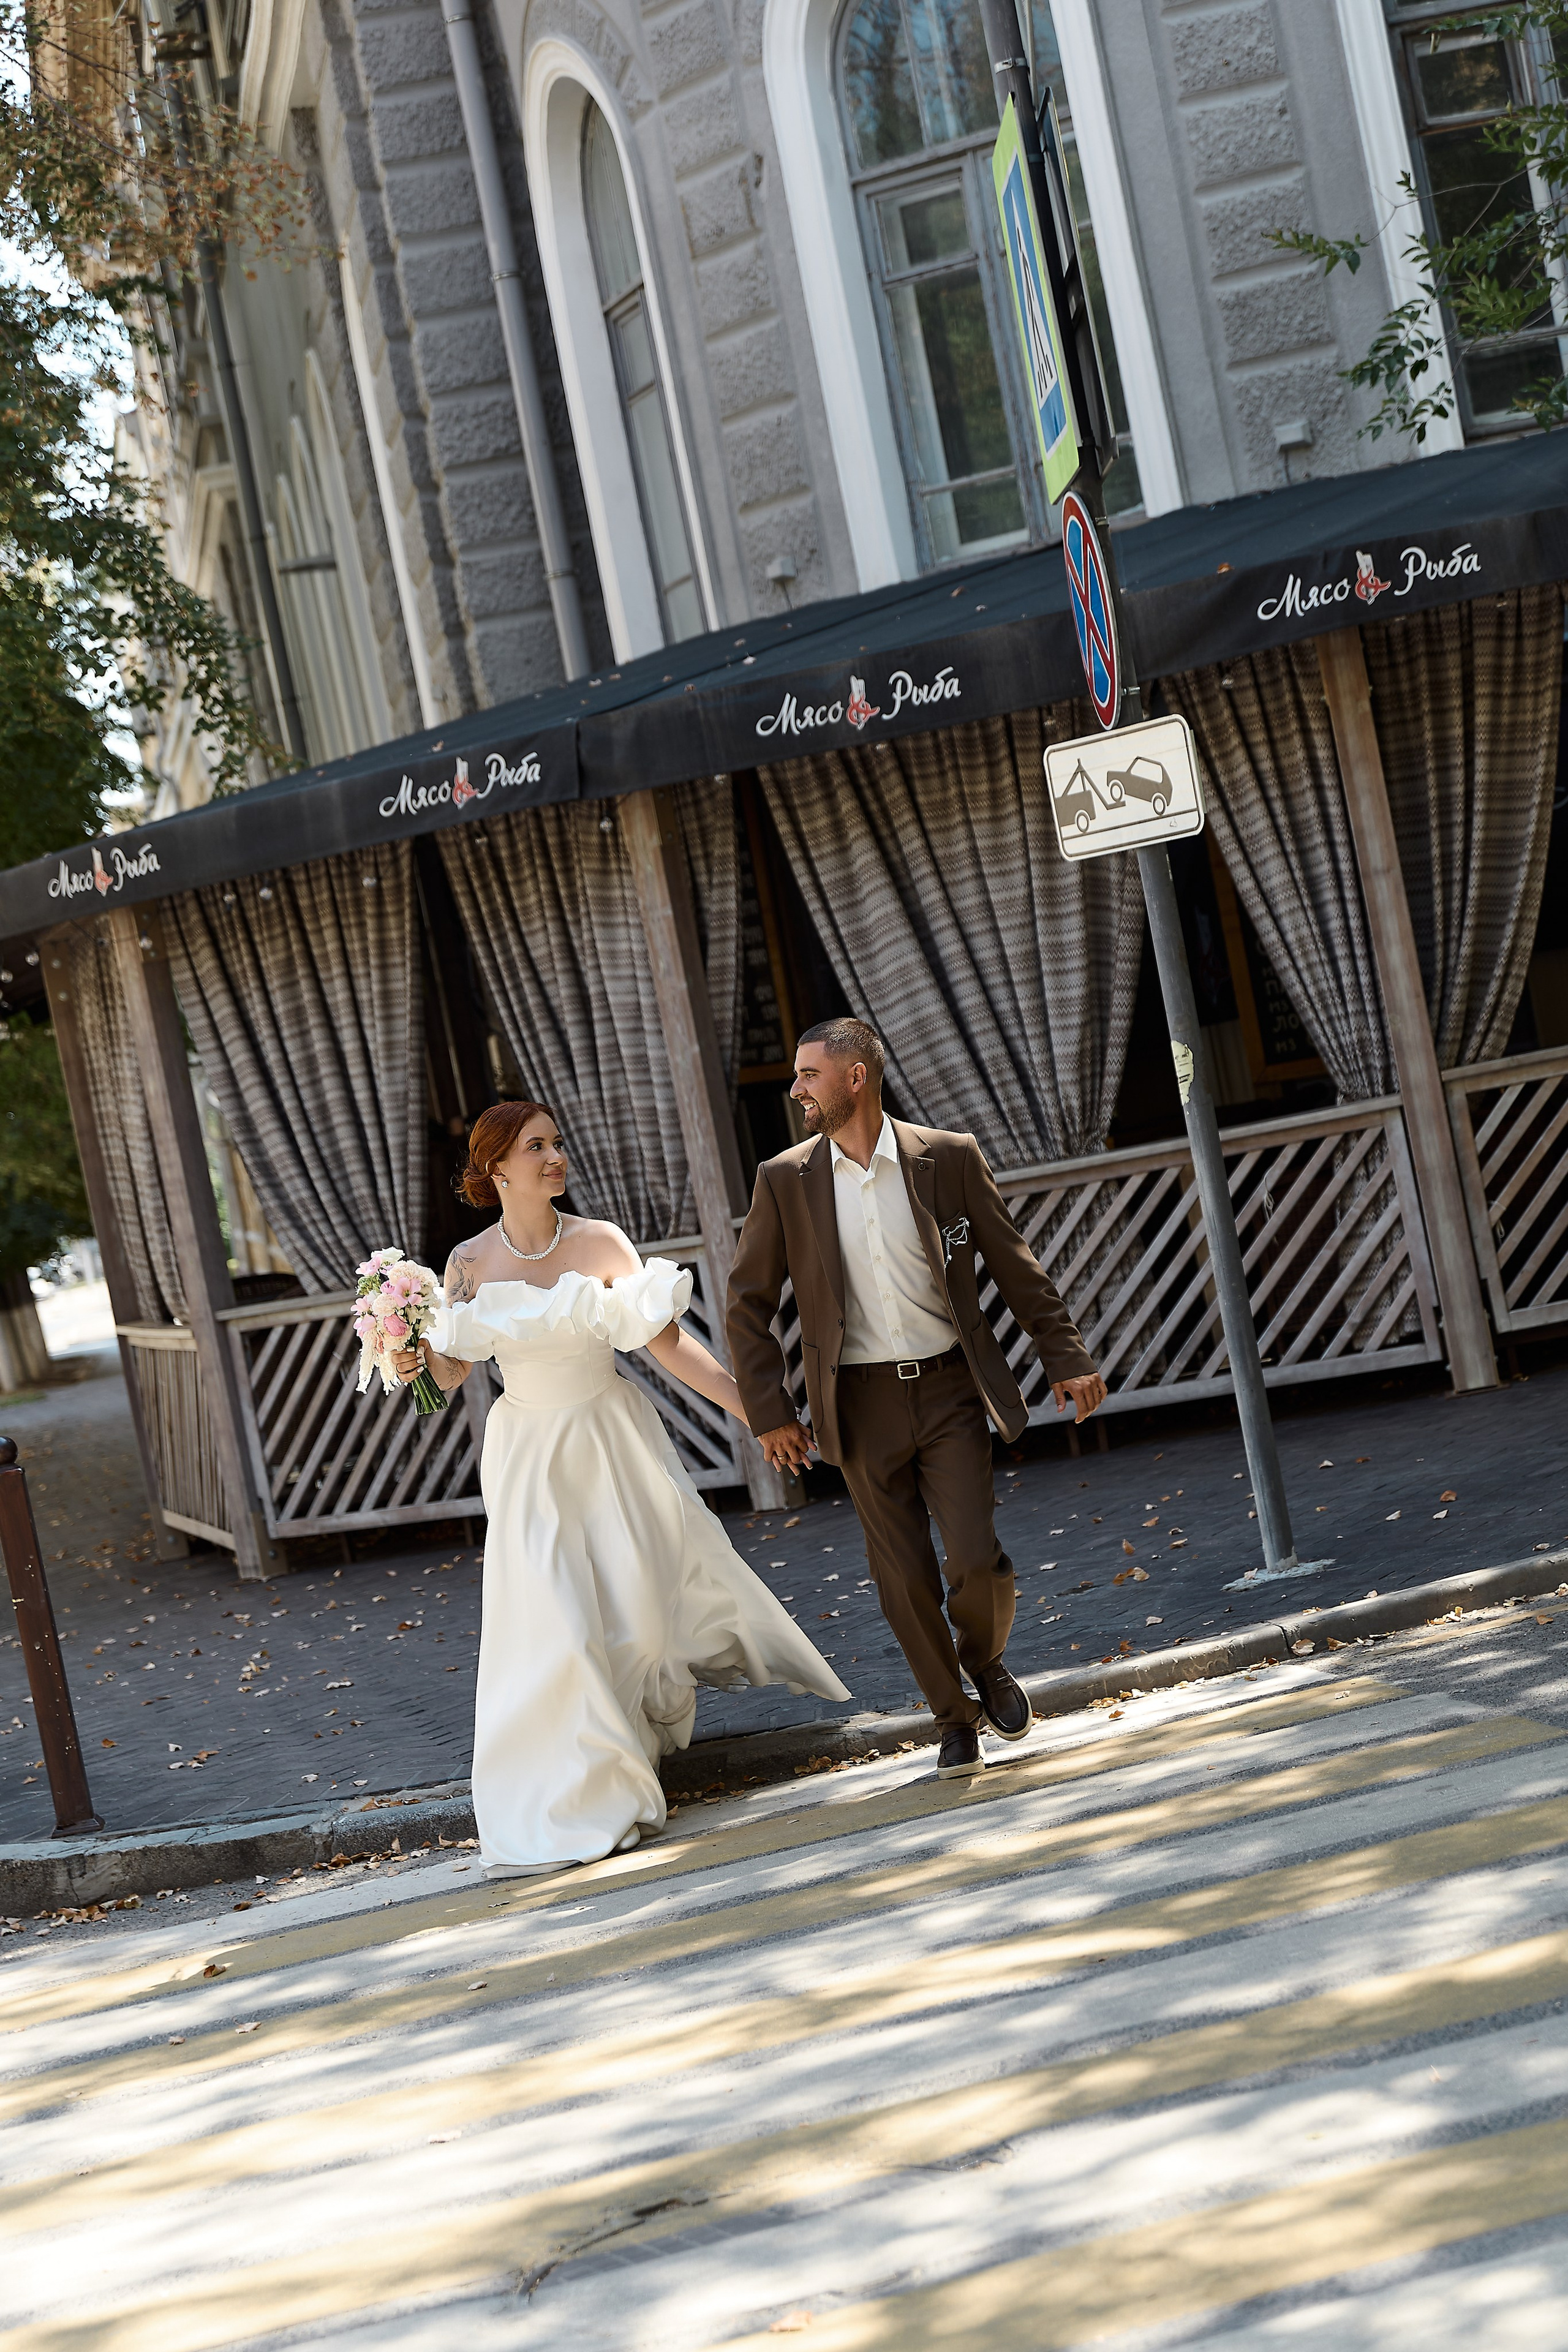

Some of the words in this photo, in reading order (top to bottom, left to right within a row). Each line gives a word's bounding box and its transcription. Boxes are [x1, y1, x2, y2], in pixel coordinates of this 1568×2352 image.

[1257, 573, 1351, 620] Мясо
[1393, 543, 1482, 596] Рыба
[755, 692, 845, 736] Мясо
[881, 666, 962, 720] Рыба
[379, 774, 452, 817] Мясо
[475, 752, 542, 799] Рыба
[48, 859, 94, 899] Мясо
[110, 843, 161, 892] Рыба
